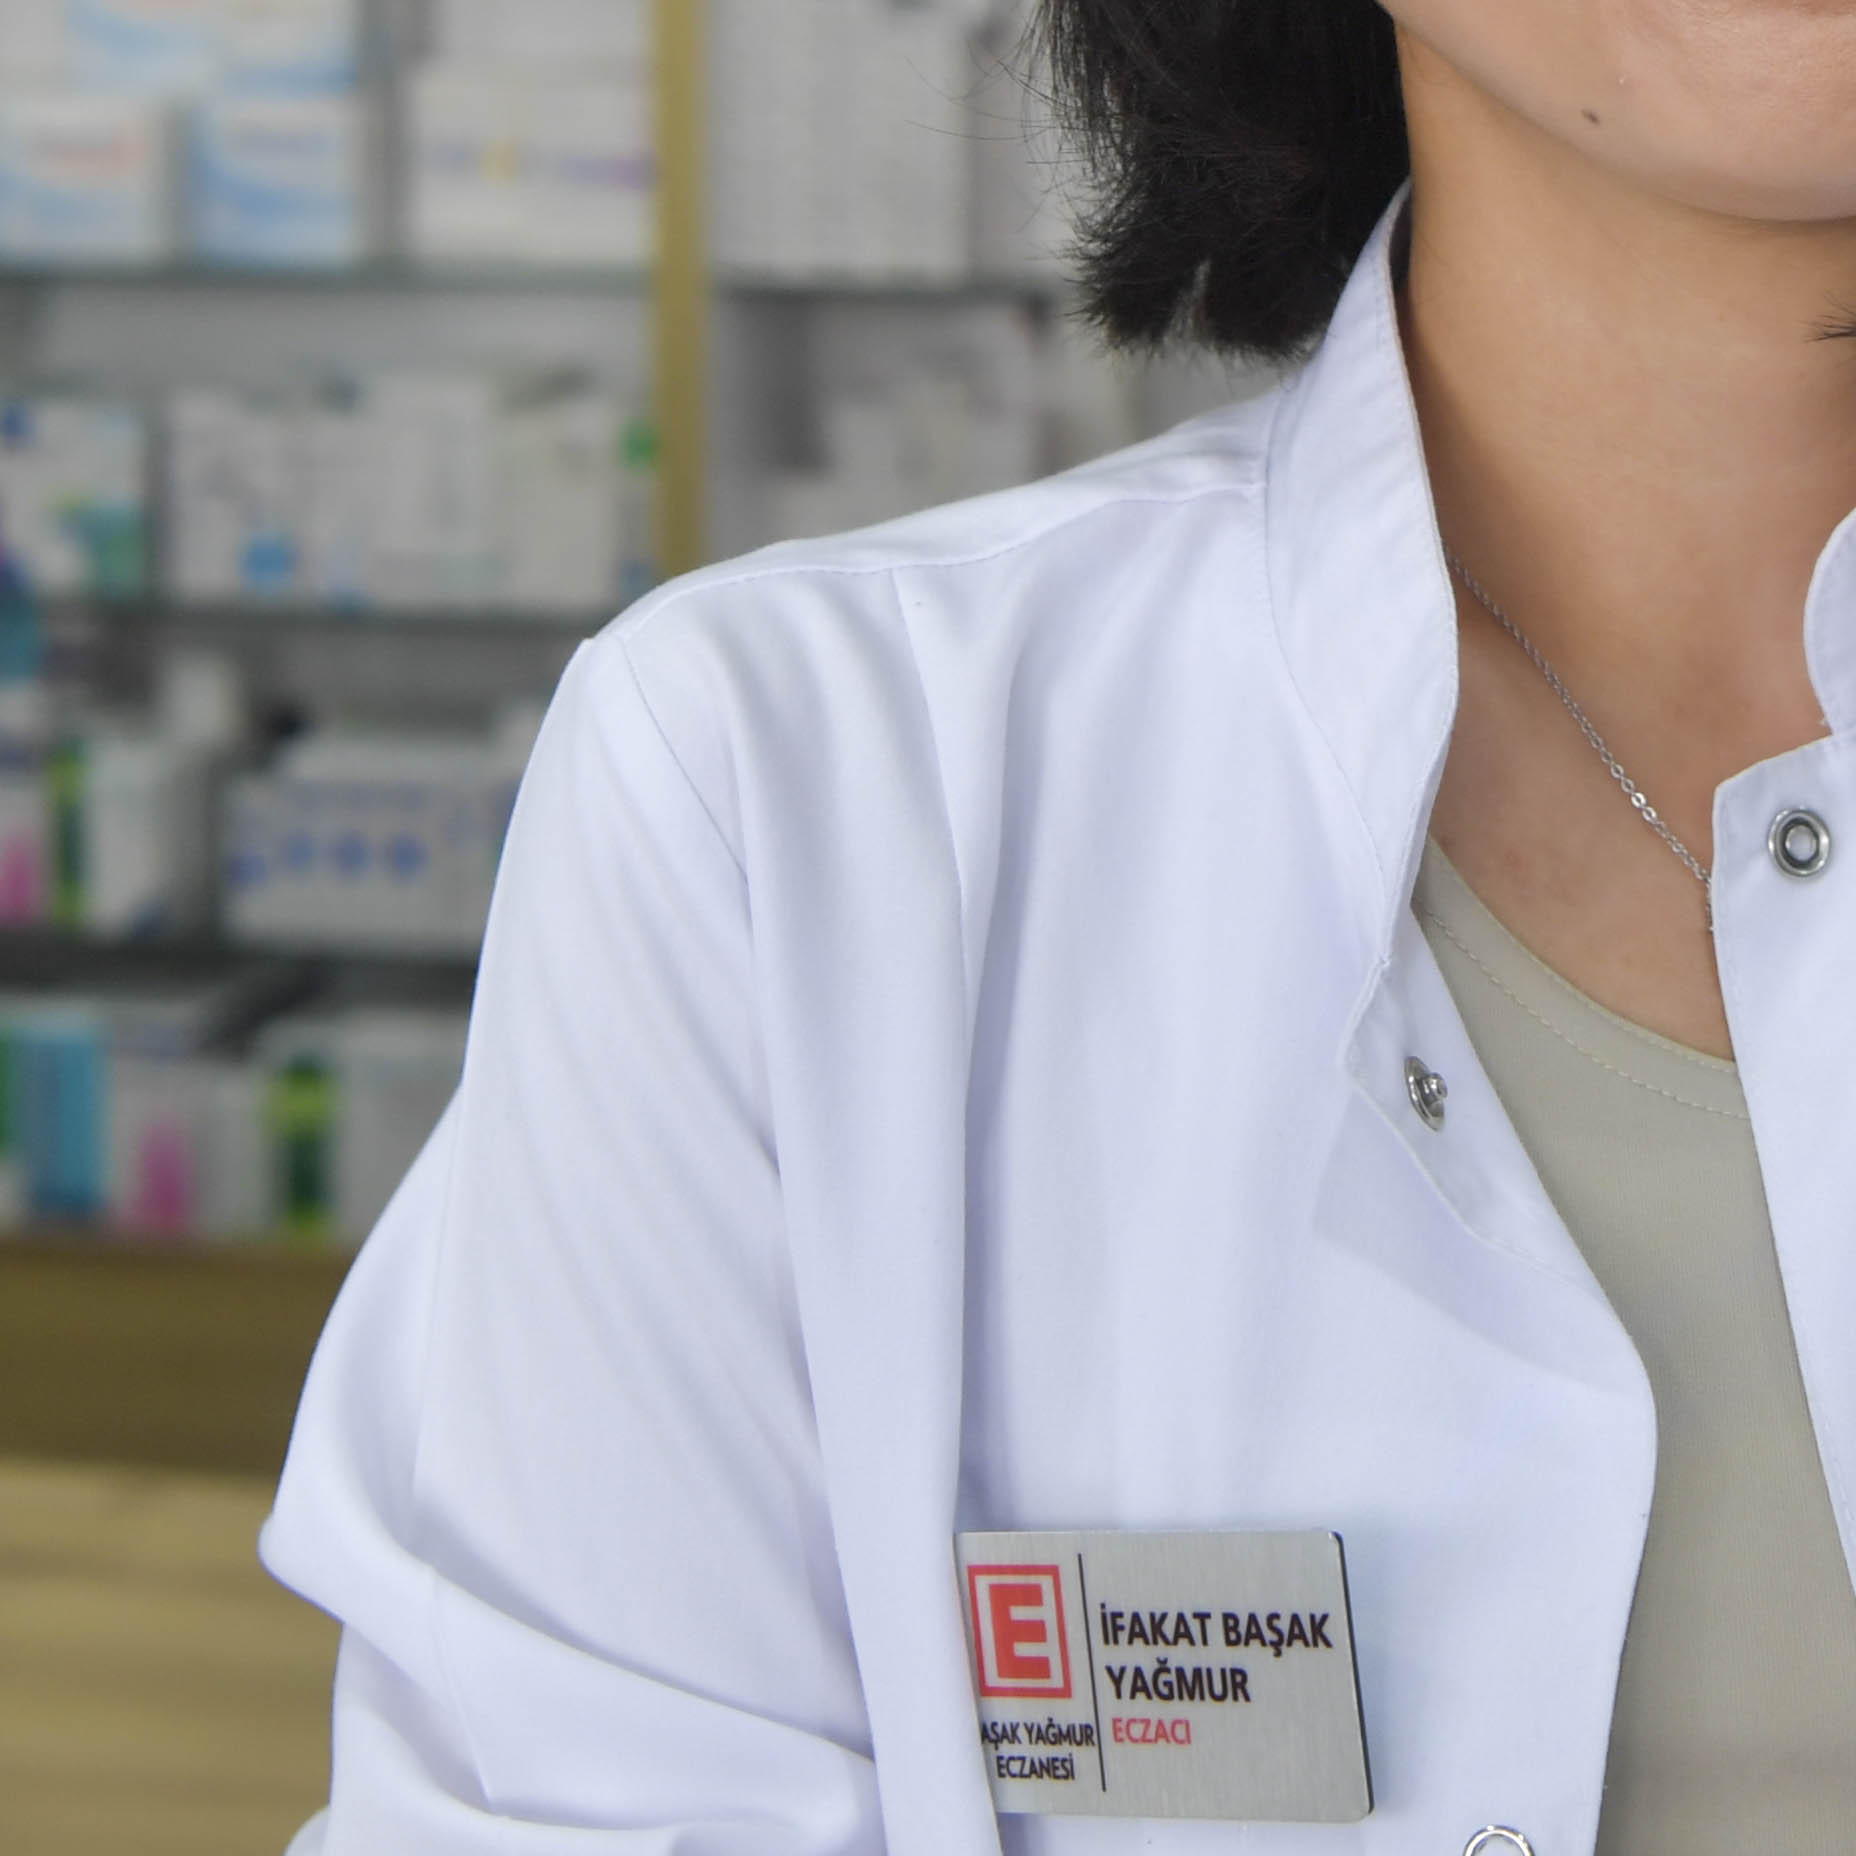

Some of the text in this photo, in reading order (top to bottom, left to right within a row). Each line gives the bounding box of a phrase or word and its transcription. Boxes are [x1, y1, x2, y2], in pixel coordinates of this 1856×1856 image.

[987, 1582, 1052, 1680] E
[1099, 1602, 1334, 1658] İFAKAT BAŞAK
[1105, 1656, 1251, 1703] YAĞMUR
[981, 1716, 1095, 1751] AŞAK YAĞMUR
[1111, 1717, 1192, 1745] ECZACI
[996, 1752, 1075, 1781] ECZANESİ
